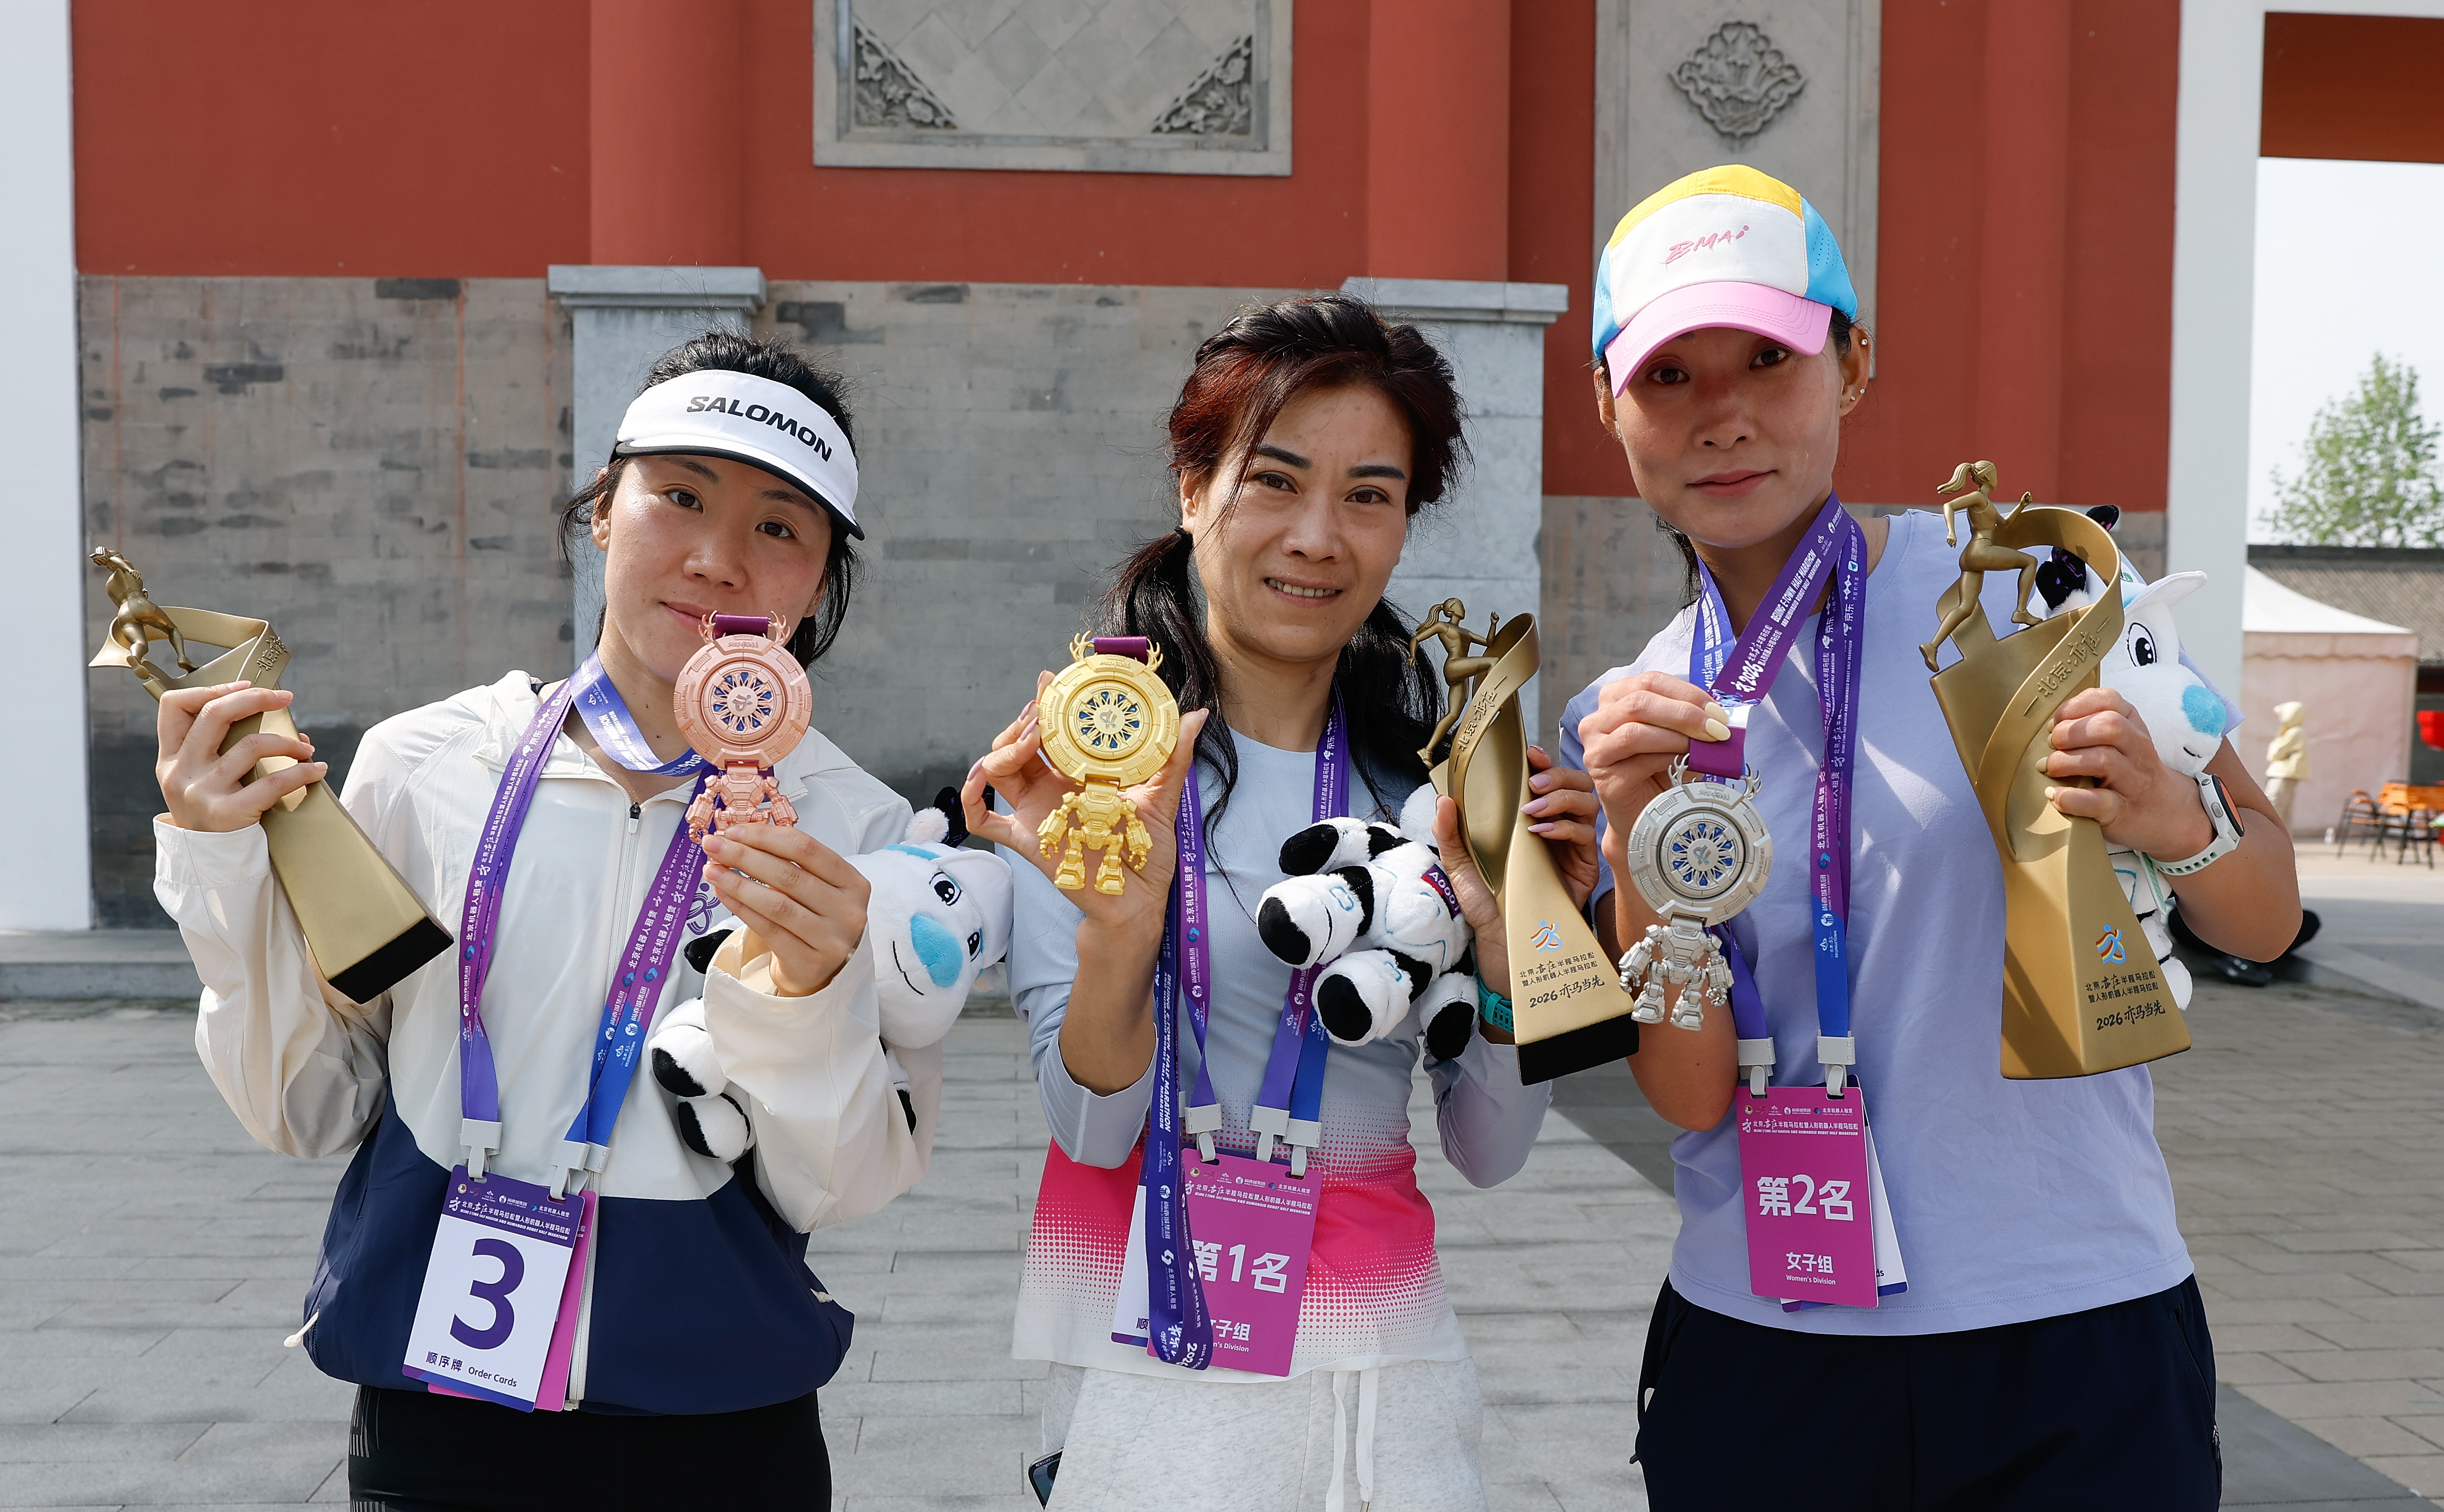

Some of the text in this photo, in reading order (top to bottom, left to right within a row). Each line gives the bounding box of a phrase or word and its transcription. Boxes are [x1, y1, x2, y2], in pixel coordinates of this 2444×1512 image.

[686, 396, 833, 462] SALOMON
[1770, 549, 1819, 623] BEIJING E-TOWN HALF MARATHON
[1780, 558, 1823, 627] AND HUMANOID ROBOT HALF MARATHON
[1825, 615, 1834, 634] 京东
[1844, 603, 1854, 621] 京东
[1743, 660, 1765, 688] 2026
[1327, 735, 1335, 749] 京东
[1817, 786, 1826, 848] 北京机器人租赁
[1184, 865, 1195, 923] 北京机器人租赁
[465, 879, 482, 941] 北京机器人租赁
[627, 908, 657, 969] 北京机器人租赁
[648, 903, 678, 965] 北京机器人租赁
[1522, 961, 1598, 987] 暨人形机器人半程马拉松
[1529, 990, 1558, 1008] 2026
[2088, 982, 2158, 1003] 暨人形机器人半程马拉松
[2096, 1012, 2123, 1031] 2026
[1278, 1184, 1310, 1194] 北京机器人租赁
[1757, 1174, 1853, 1221] 第2名
[539, 1205, 569, 1217] 北京机器人租赁
[1192, 1240, 1290, 1294] 第1名
[1786, 1252, 1833, 1274] 女子组
[1168, 1268, 1176, 1309] 北京机器人租赁
[1786, 1274, 1836, 1285] Women's Division
[449, 1238, 525, 1350] 3
[1224, 1343, 1249, 1353] Division
[426, 1351, 517, 1387] 顺序牌 Order Cards
[1036, 1457, 1053, 1467] CARTOON
